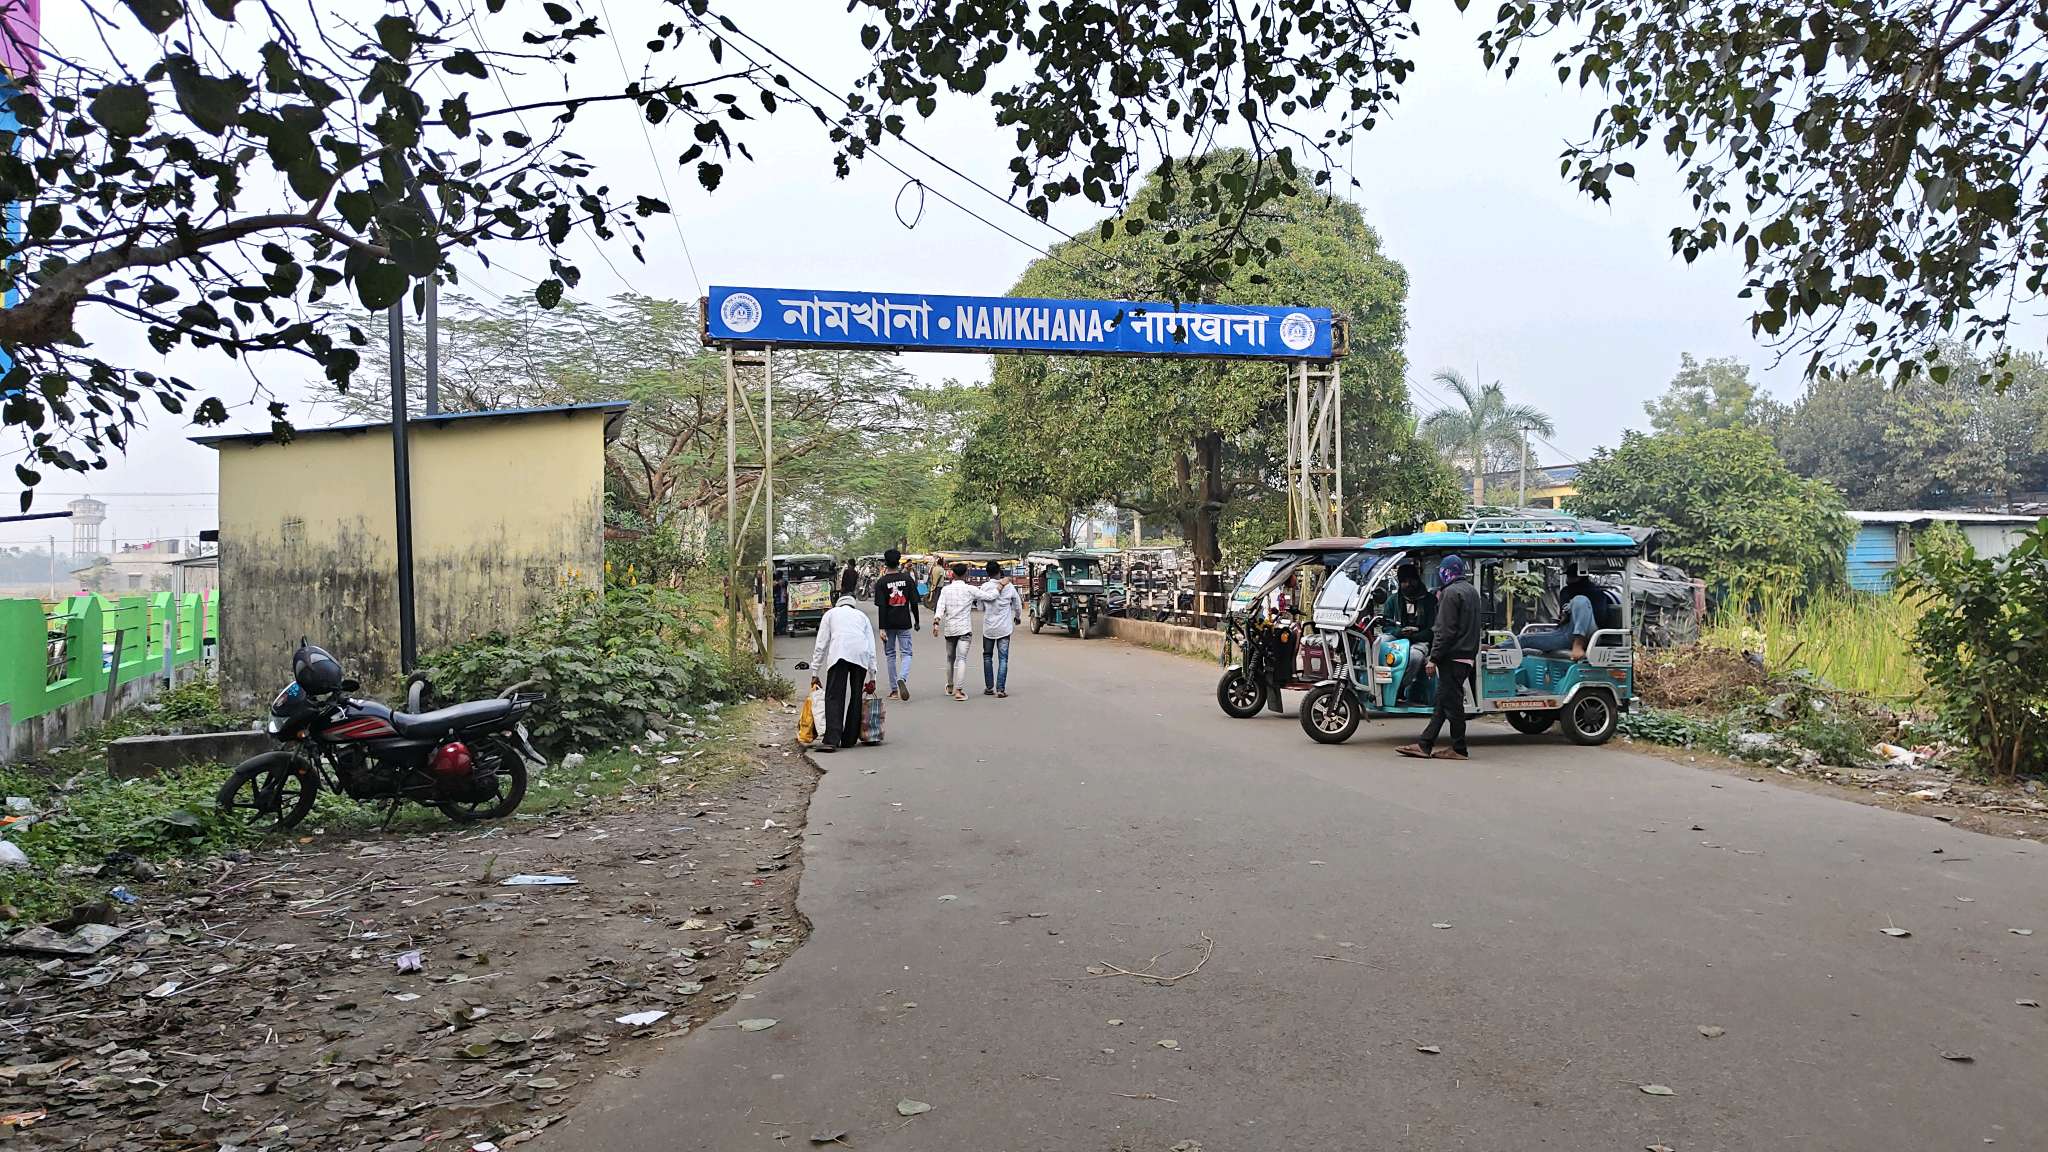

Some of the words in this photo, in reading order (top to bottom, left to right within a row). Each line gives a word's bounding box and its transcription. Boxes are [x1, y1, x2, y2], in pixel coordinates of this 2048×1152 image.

[777, 295, 933, 340] নামখানা
[956, 305, 1104, 343] NAMKHANA
[1128, 311, 1270, 347] नामखाना
